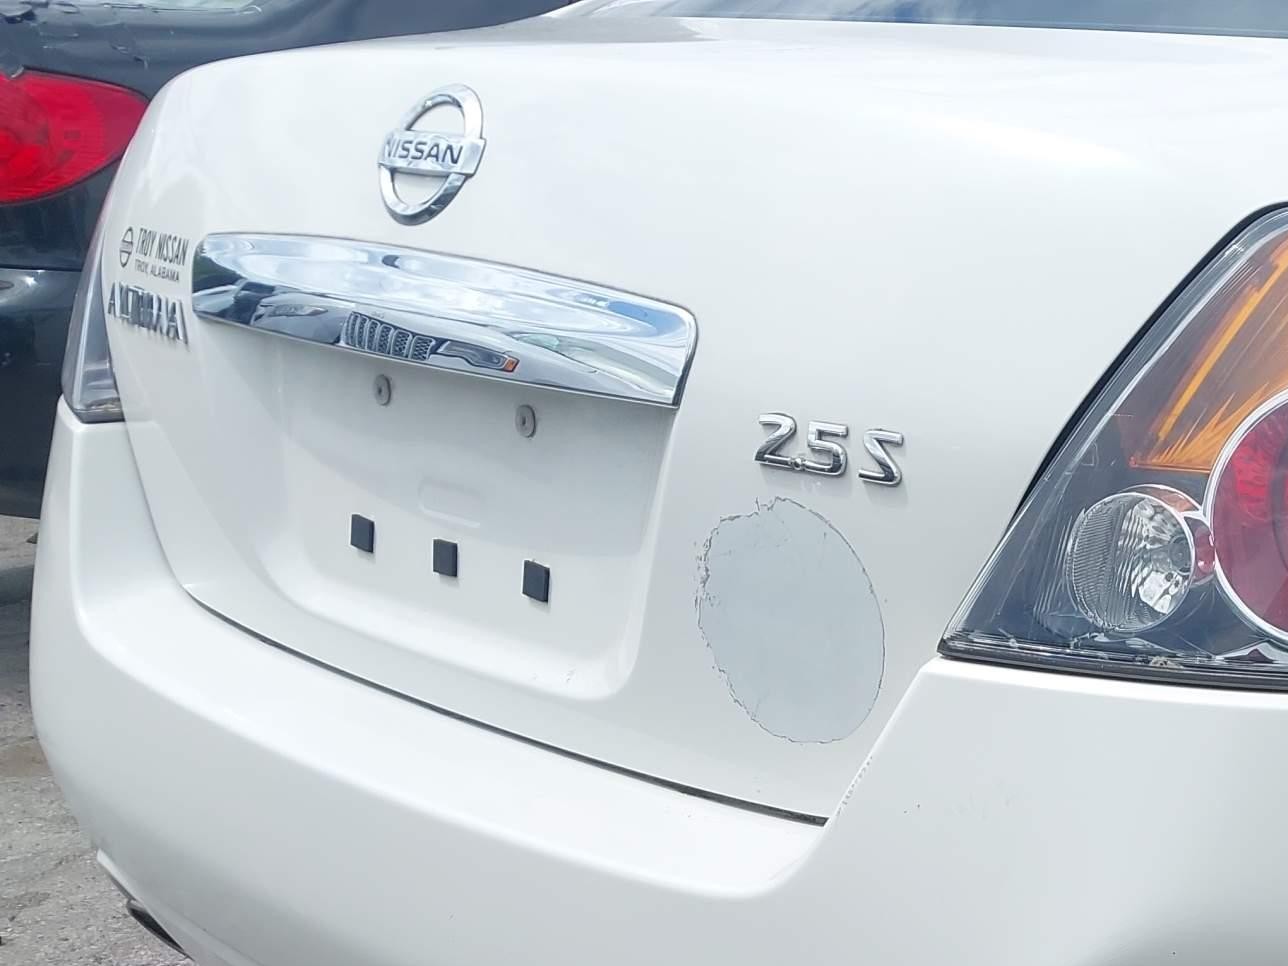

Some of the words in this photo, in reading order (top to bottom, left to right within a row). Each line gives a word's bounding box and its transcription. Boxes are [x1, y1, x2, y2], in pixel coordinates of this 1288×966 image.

[384, 138, 463, 165] NISSAN
[136, 228, 156, 254] TROY
[157, 234, 189, 265] NISSAN
[150, 266, 180, 281] ALABAMA
[858, 428, 904, 487] S
